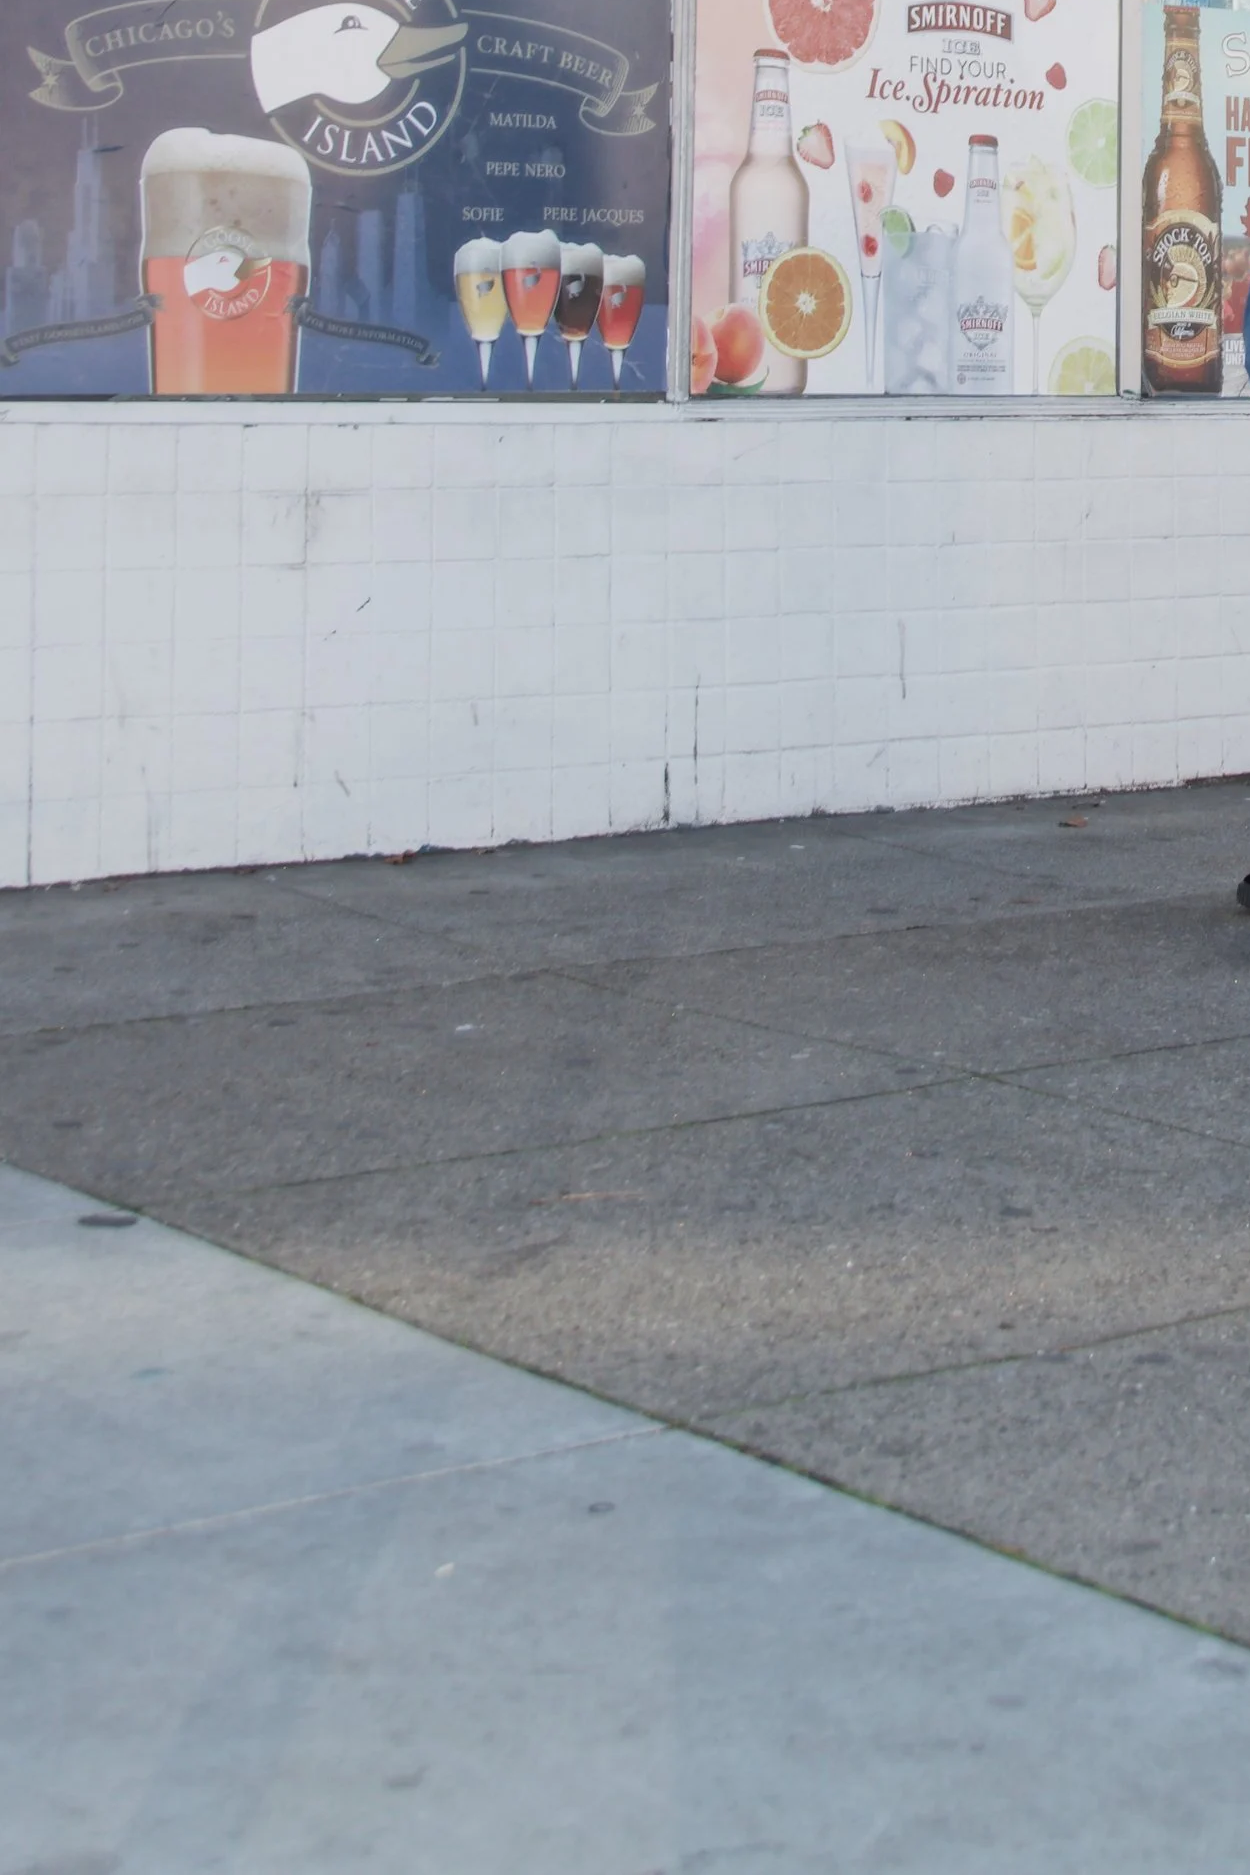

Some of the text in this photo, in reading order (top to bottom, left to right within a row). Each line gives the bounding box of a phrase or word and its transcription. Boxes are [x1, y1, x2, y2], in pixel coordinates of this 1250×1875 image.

[910, 4, 1007, 36] SMIRNOFF
[85, 11, 235, 59] CHICAGO'S
[942, 38, 980, 55] ICE
[477, 34, 613, 89] CRAFT BEER
[909, 55, 1007, 80] FIND YOUR
[490, 112, 557, 130] MATILDA
[302, 99, 440, 166] ISLAND
[486, 161, 566, 179] PEPE NERO
[462, 207, 645, 227] SOFIE PERE JACQUES
[1153, 228, 1212, 266] SHOCK TOP
[745, 260, 773, 275] SMIR
[204, 288, 259, 316] ISLAND
[961, 317, 1002, 331] SMIRNOFF
[1154, 309, 1212, 320] BELGIAN WHITE
